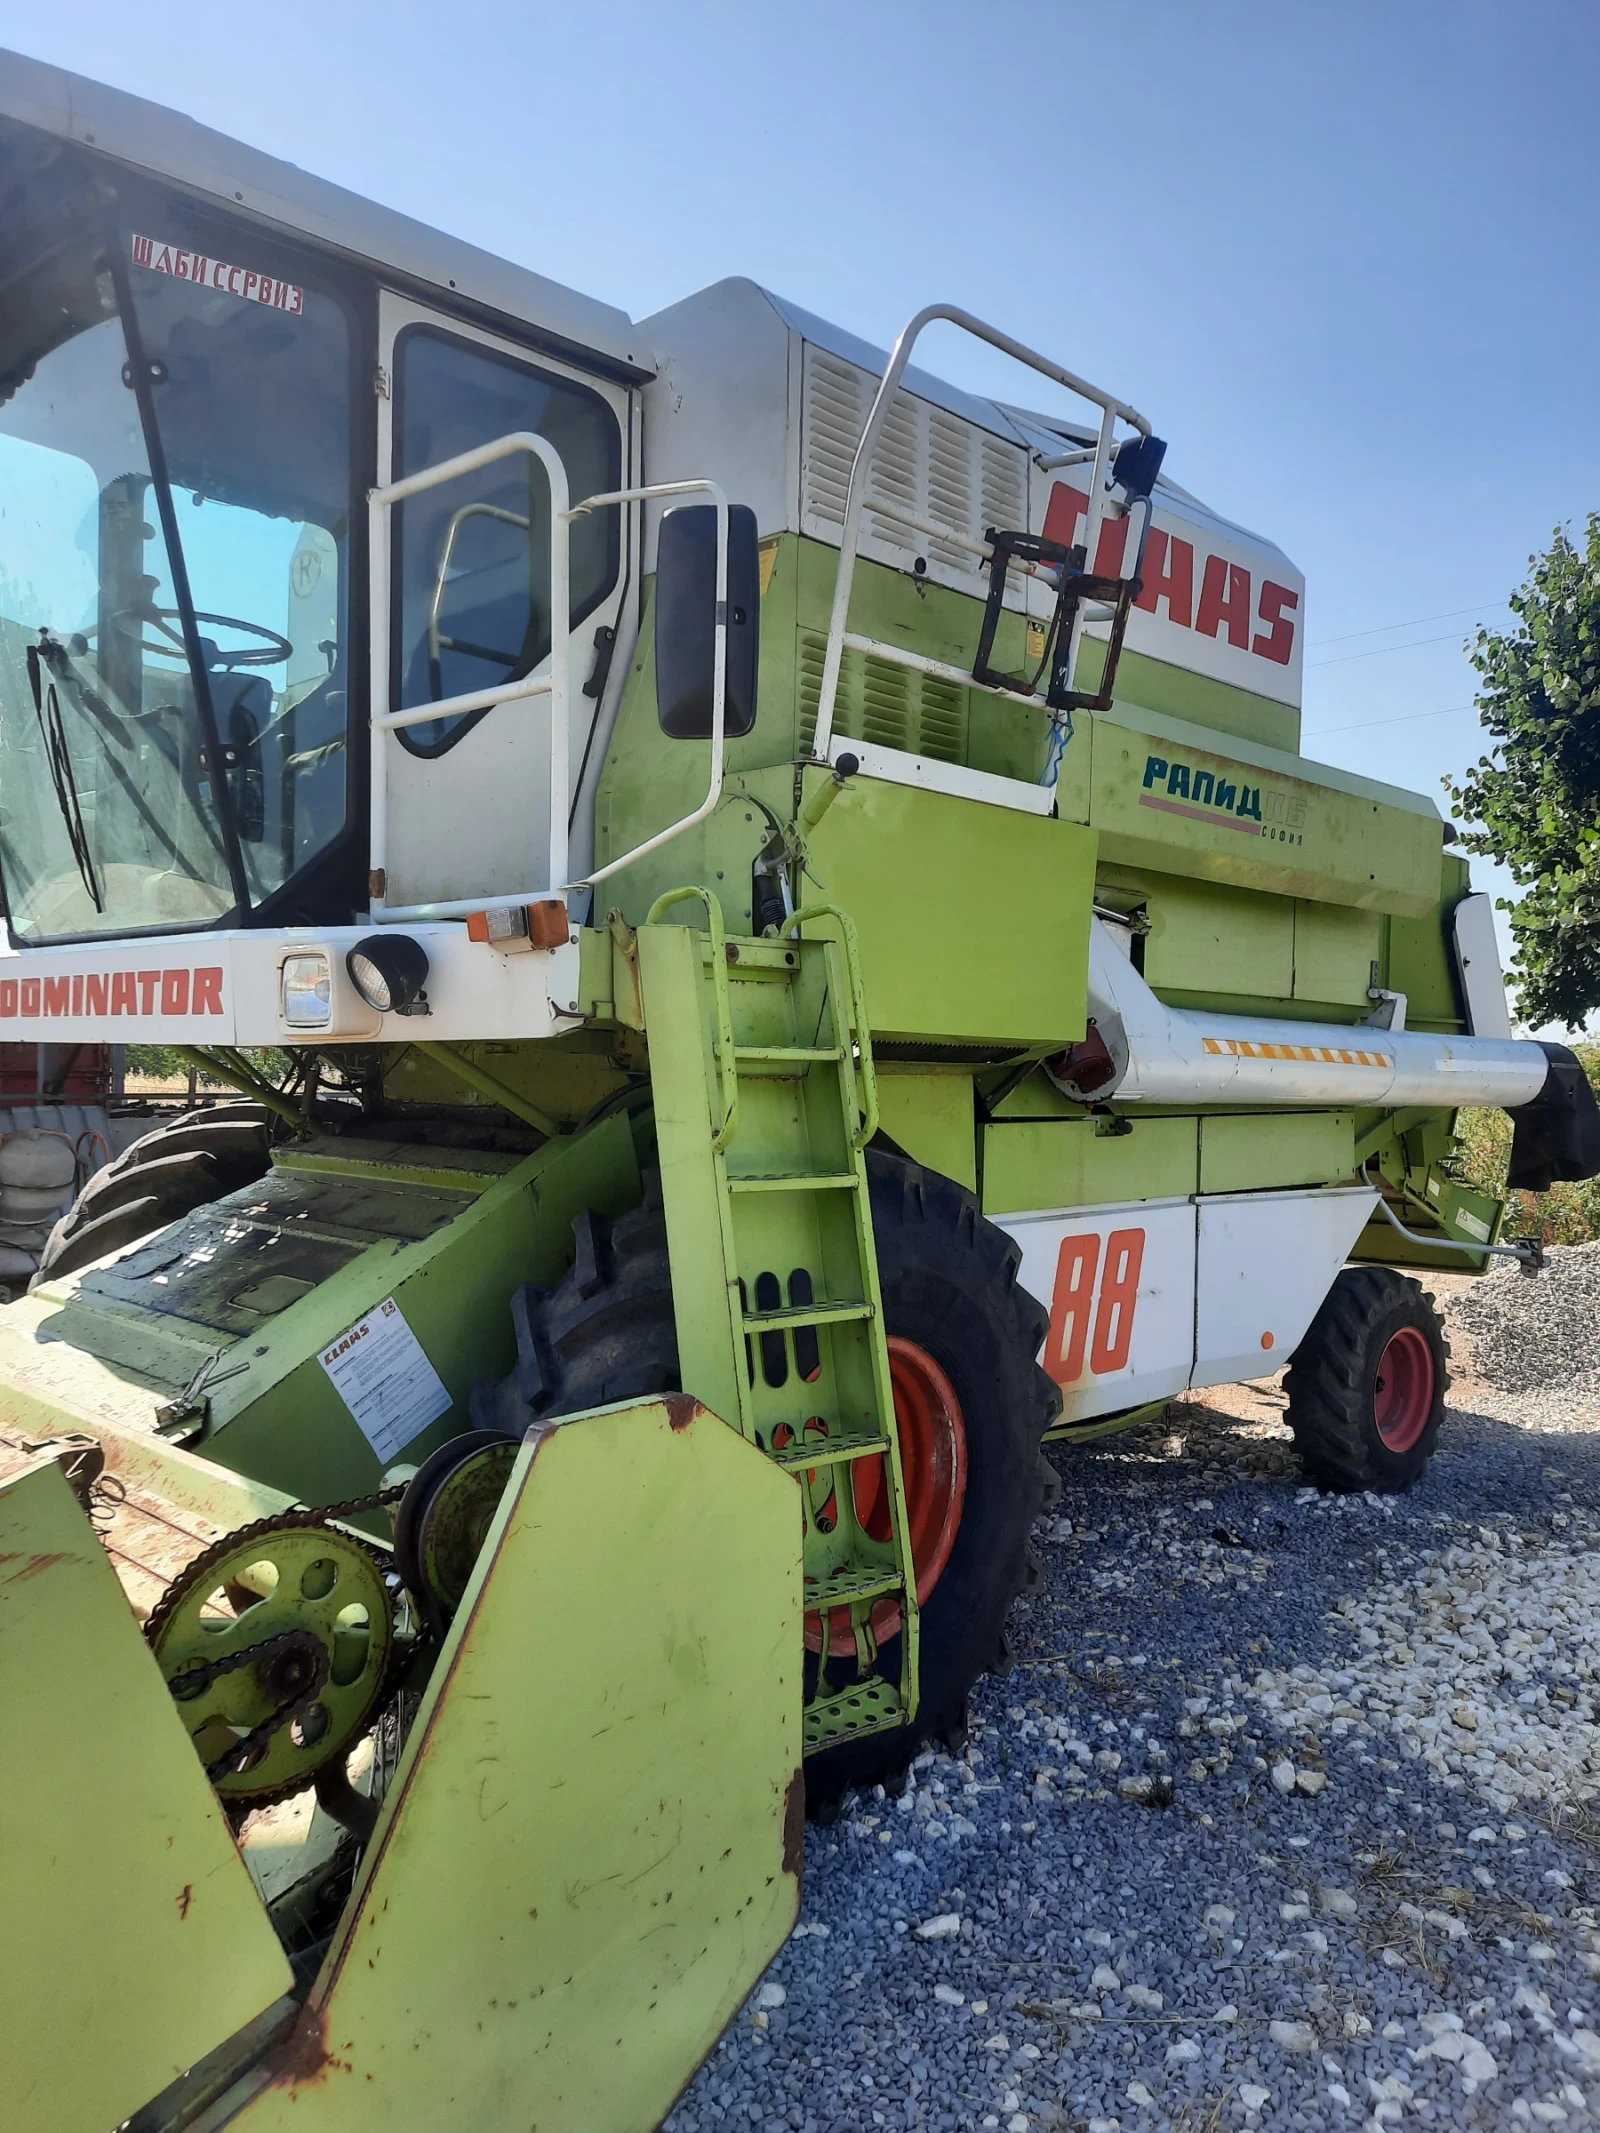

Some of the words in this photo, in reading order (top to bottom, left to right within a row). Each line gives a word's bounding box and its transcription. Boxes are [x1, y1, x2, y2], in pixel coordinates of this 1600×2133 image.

[1261, 825, 1303, 847] СОФИЯ
[0, 966, 224, 1018] DOMINATOR
[1042, 1227, 1146, 1385] 88
[323, 1323, 370, 1366] CLAAS
